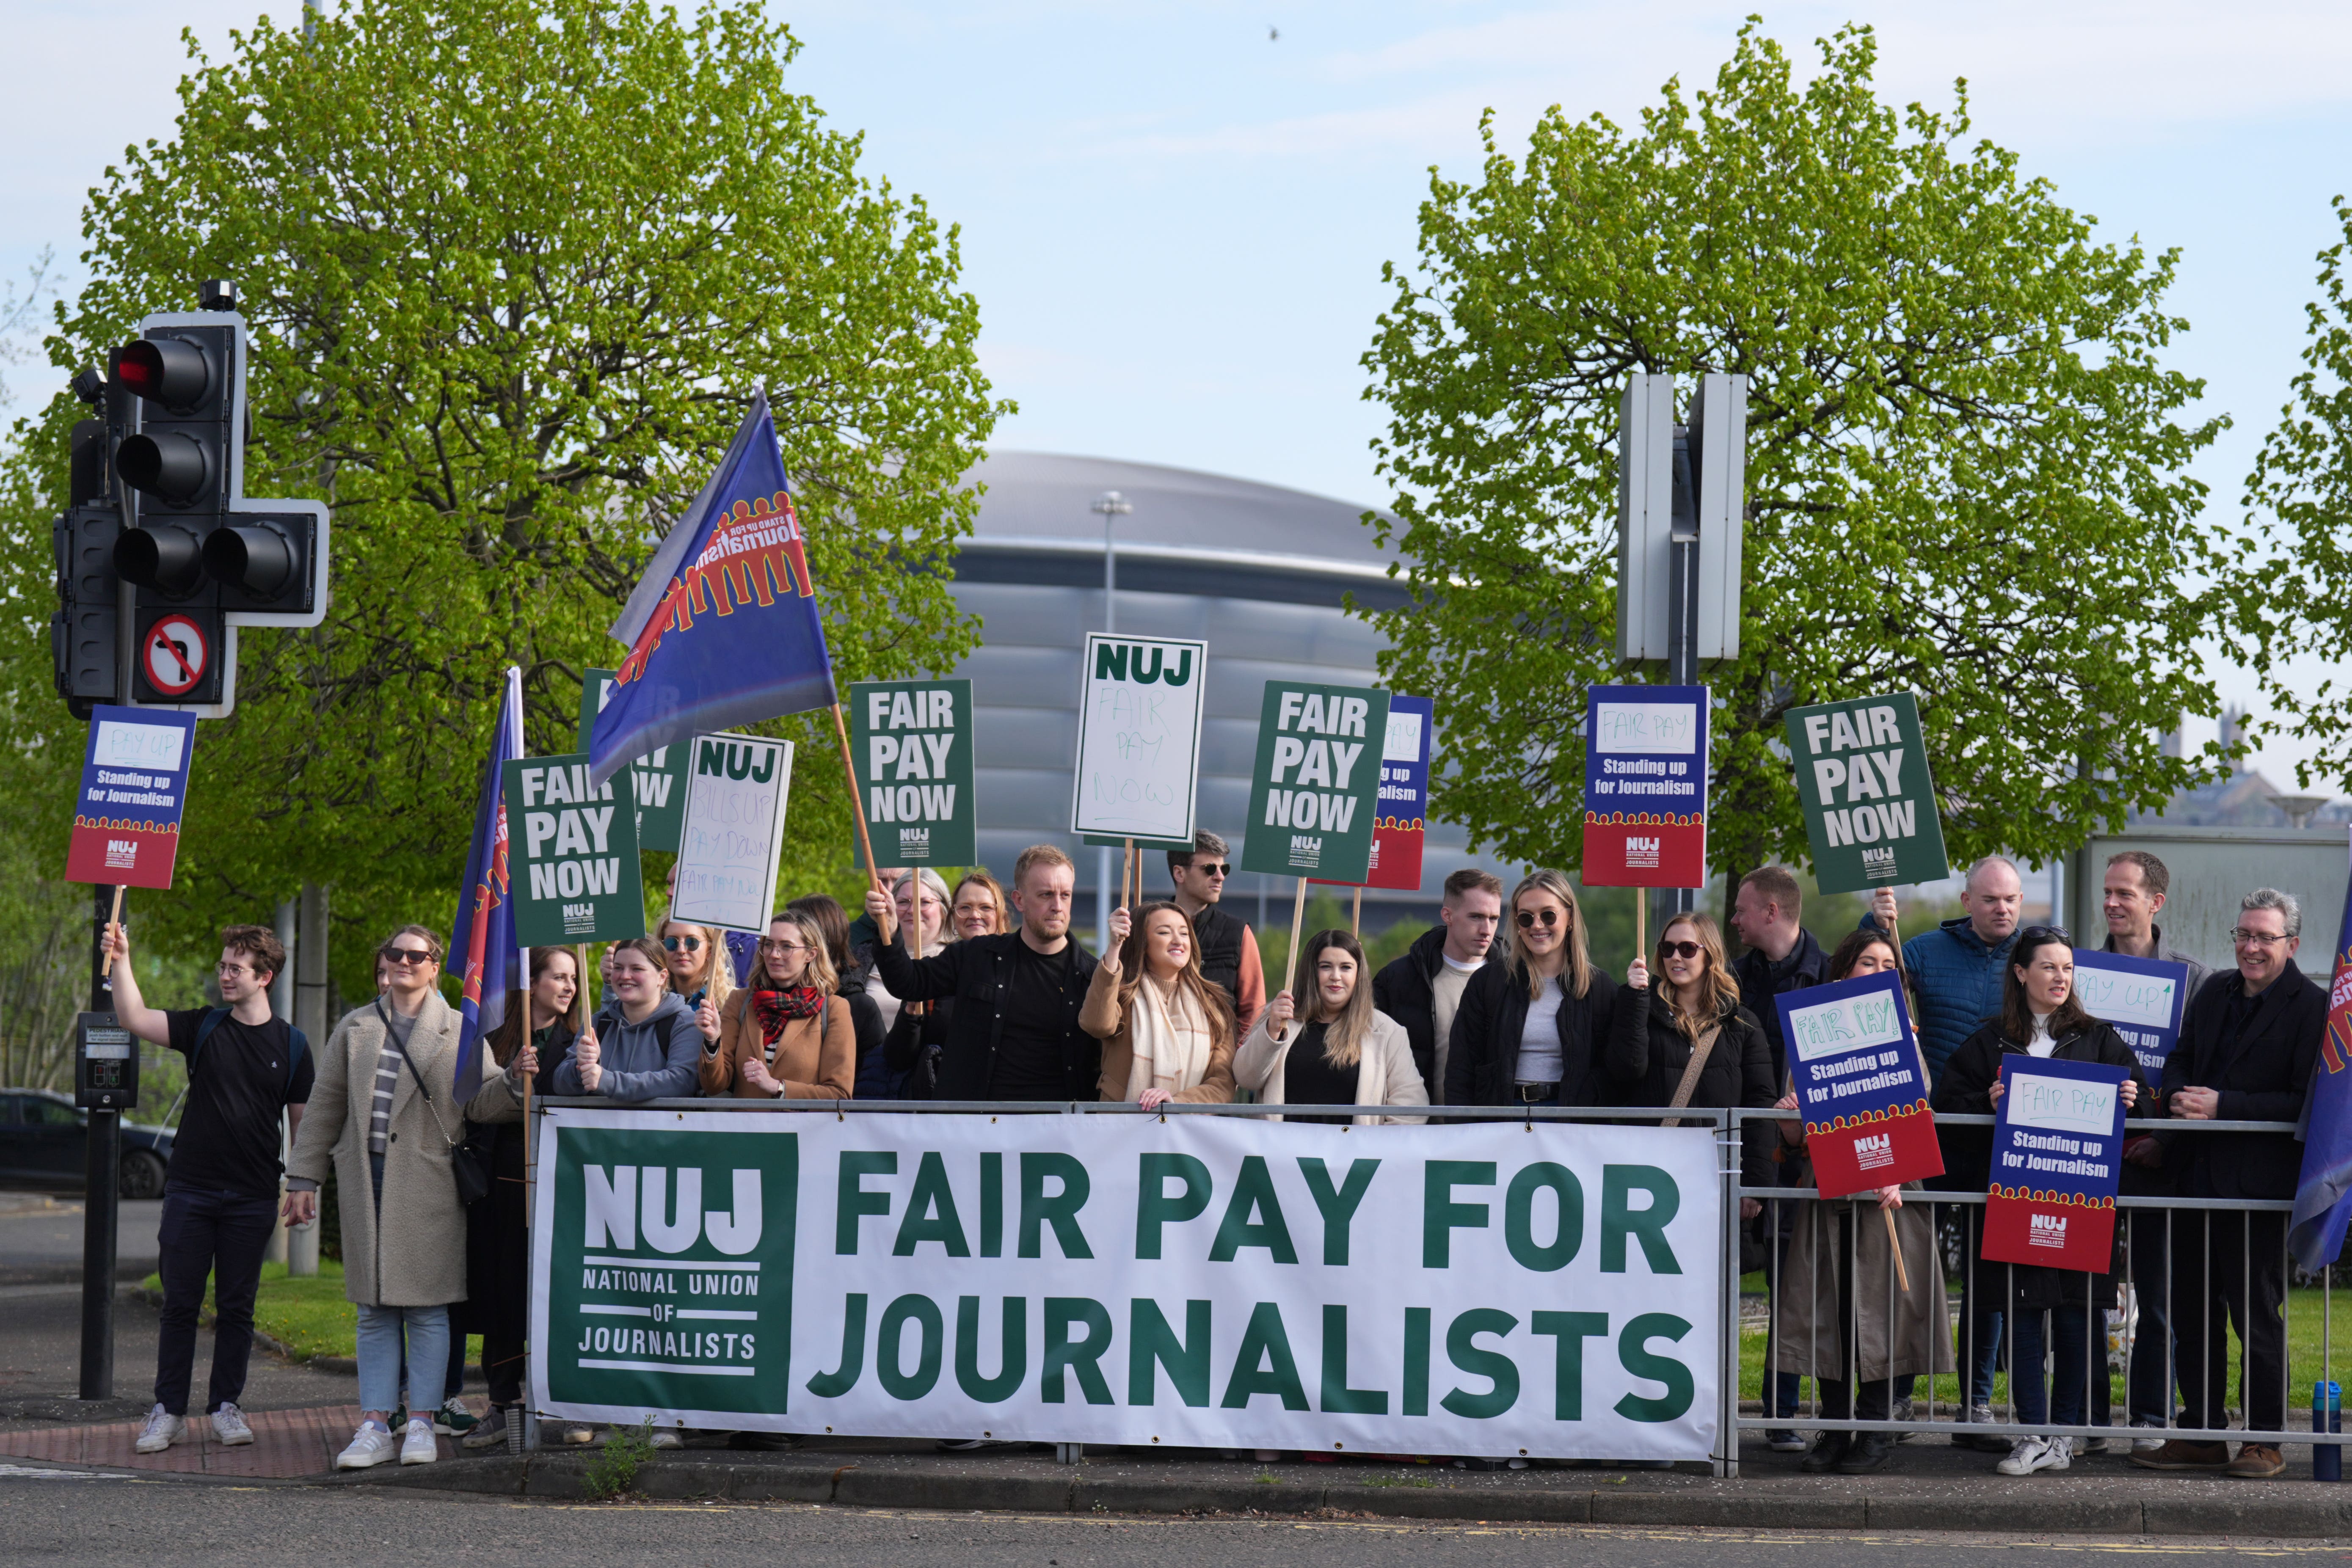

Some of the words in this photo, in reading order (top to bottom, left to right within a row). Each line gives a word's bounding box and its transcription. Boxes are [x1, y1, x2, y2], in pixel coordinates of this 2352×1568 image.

[1096, 643, 1192, 686] NUJ
[869, 690, 954, 730] FAIR
[1098, 688, 1171, 736] FAIR
[1277, 692, 1368, 738] FAIR
[1603, 711, 1648, 742] FAIR
[1654, 714, 1687, 741] PAY
[112, 729, 145, 753] PAY
[151, 734, 176, 758] UP
[1804, 705, 1902, 754] FAIR
[698, 740, 775, 783] NUJ
[870, 733, 954, 780] PAY
[1117, 732, 1162, 768] PAY
[1270, 736, 1364, 789] PAY
[97, 770, 154, 788] Standing
[154, 777, 170, 789] up
[1392, 768, 1410, 782] up
[1604, 758, 1666, 776] Standing
[1669, 762, 1687, 775] up
[1813, 748, 1904, 805] PAY
[87, 788, 106, 802] for
[107, 788, 174, 807] Journalism
[871, 784, 956, 822] NOW
[1094, 772, 1173, 806] NOW
[1595, 779, 1615, 794] for
[1618, 780, 1694, 795] Journalism
[1265, 788, 1357, 833] NOW
[1823, 799, 1915, 847] NOW
[107, 840, 138, 854] NUJ
[525, 806, 615, 858] PAY
[687, 827, 720, 858] PAY
[726, 831, 768, 860] DOWN
[900, 828, 929, 841] NUJ
[1290, 835, 1322, 850] NUJ
[1626, 837, 1659, 851] NUJ
[1861, 846, 1894, 863] NUJ
[529, 857, 619, 900] NOW
[682, 870, 708, 894] FAIR
[713, 875, 733, 893] PAY
[562, 903, 593, 917] NUJ
[2078, 973, 2113, 1002] PAY
[2126, 985, 2159, 1011] UP
[1796, 1009, 1855, 1053] FAIR
[1853, 998, 1898, 1036] PAY!
[2141, 1033, 2160, 1048] up
[1810, 1056, 1878, 1080] Standing
[1879, 1050, 1899, 1066] up
[1807, 1085, 1829, 1103] for
[1831, 1069, 1913, 1097] Journalism
[2022, 1082, 2061, 1113] FAIR
[2072, 1089, 2106, 1117] PAY
[1854, 1133, 1890, 1153] NUJ
[2013, 1130, 2079, 1155] Standing
[2082, 1142, 2102, 1157] up
[1859, 1157, 1894, 1168] JOURNALISTS
[2002, 1151, 2024, 1168] for
[2026, 1152, 2109, 1178] Journalism
[583, 1164, 761, 1255] NUJ
[835, 1150, 1095, 1259] FAIR
[1135, 1152, 1382, 1266] PAY
[1422, 1160, 1683, 1275] FOR
[2031, 1214, 2067, 1231] NUJ
[2029, 1237, 2064, 1246] JOURNALISTS
[583, 1269, 678, 1294] NATIONAL
[689, 1273, 758, 1296] UNION
[653, 1304, 674, 1323] OF
[578, 1327, 755, 1360] JOURNALISTS
[805, 1292, 1695, 1423] JOURNALISTS
